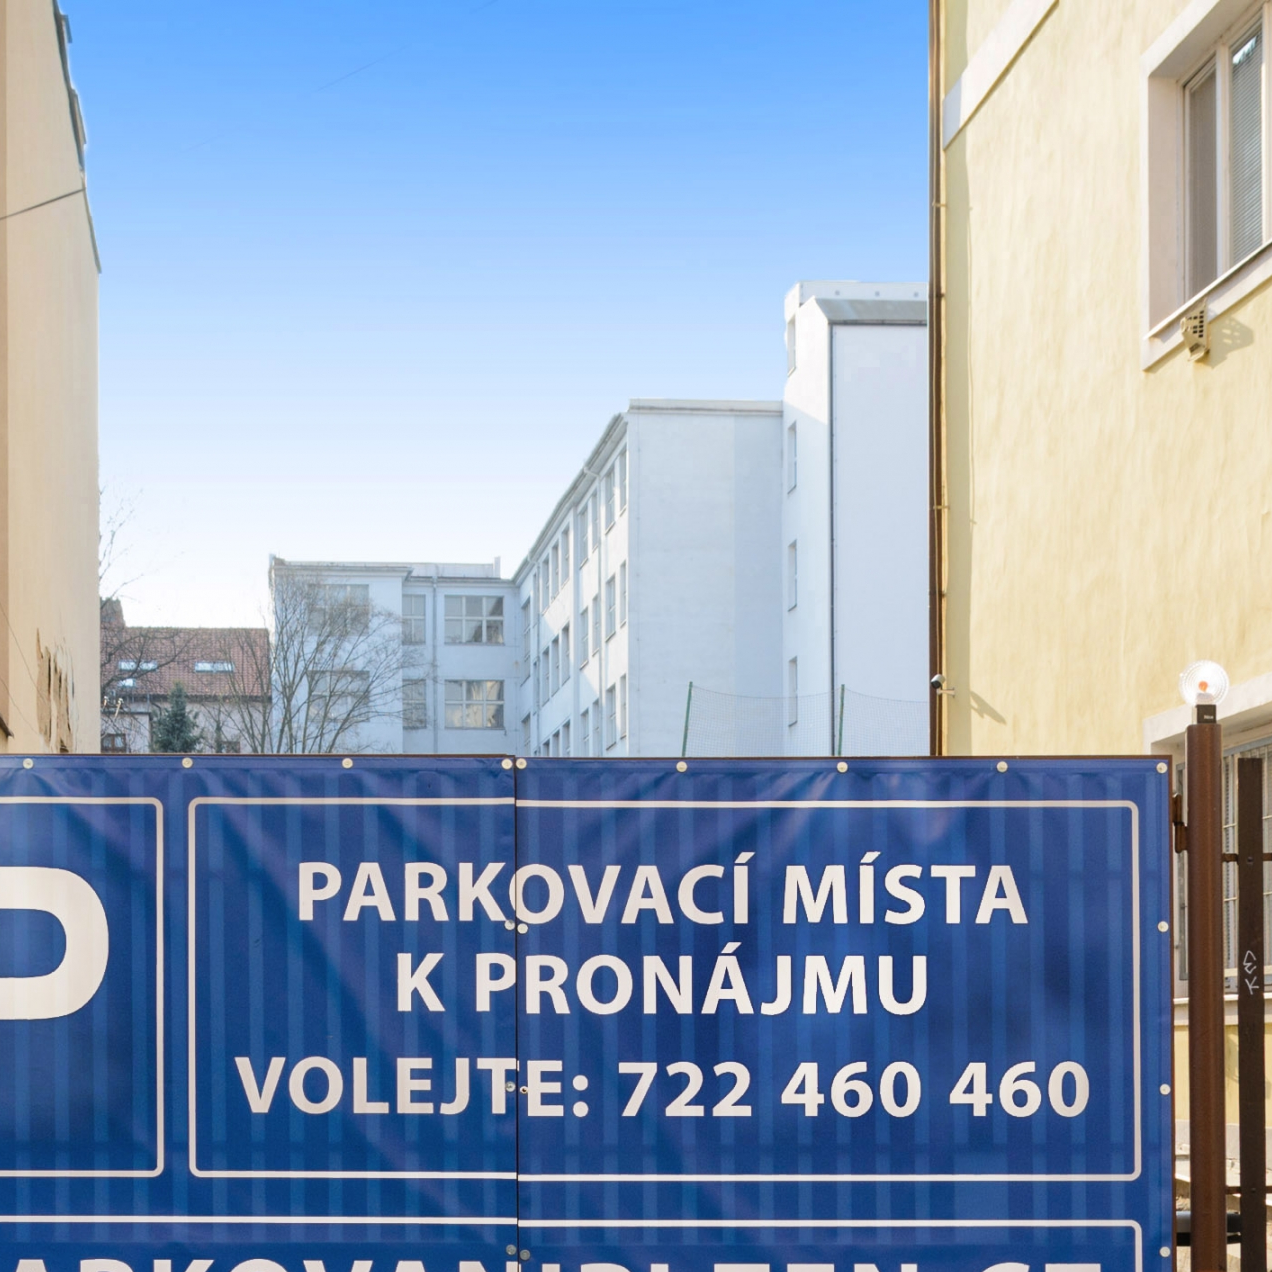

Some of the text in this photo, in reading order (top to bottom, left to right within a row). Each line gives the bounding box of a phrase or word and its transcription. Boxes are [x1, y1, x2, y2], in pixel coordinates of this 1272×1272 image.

[298, 850, 1028, 925] PARKOVACÍ MÍSTA
[397, 940, 927, 1016] K PRONÁJMU
[234, 1056, 1090, 1118] VOLEJTE: 722 460 460
